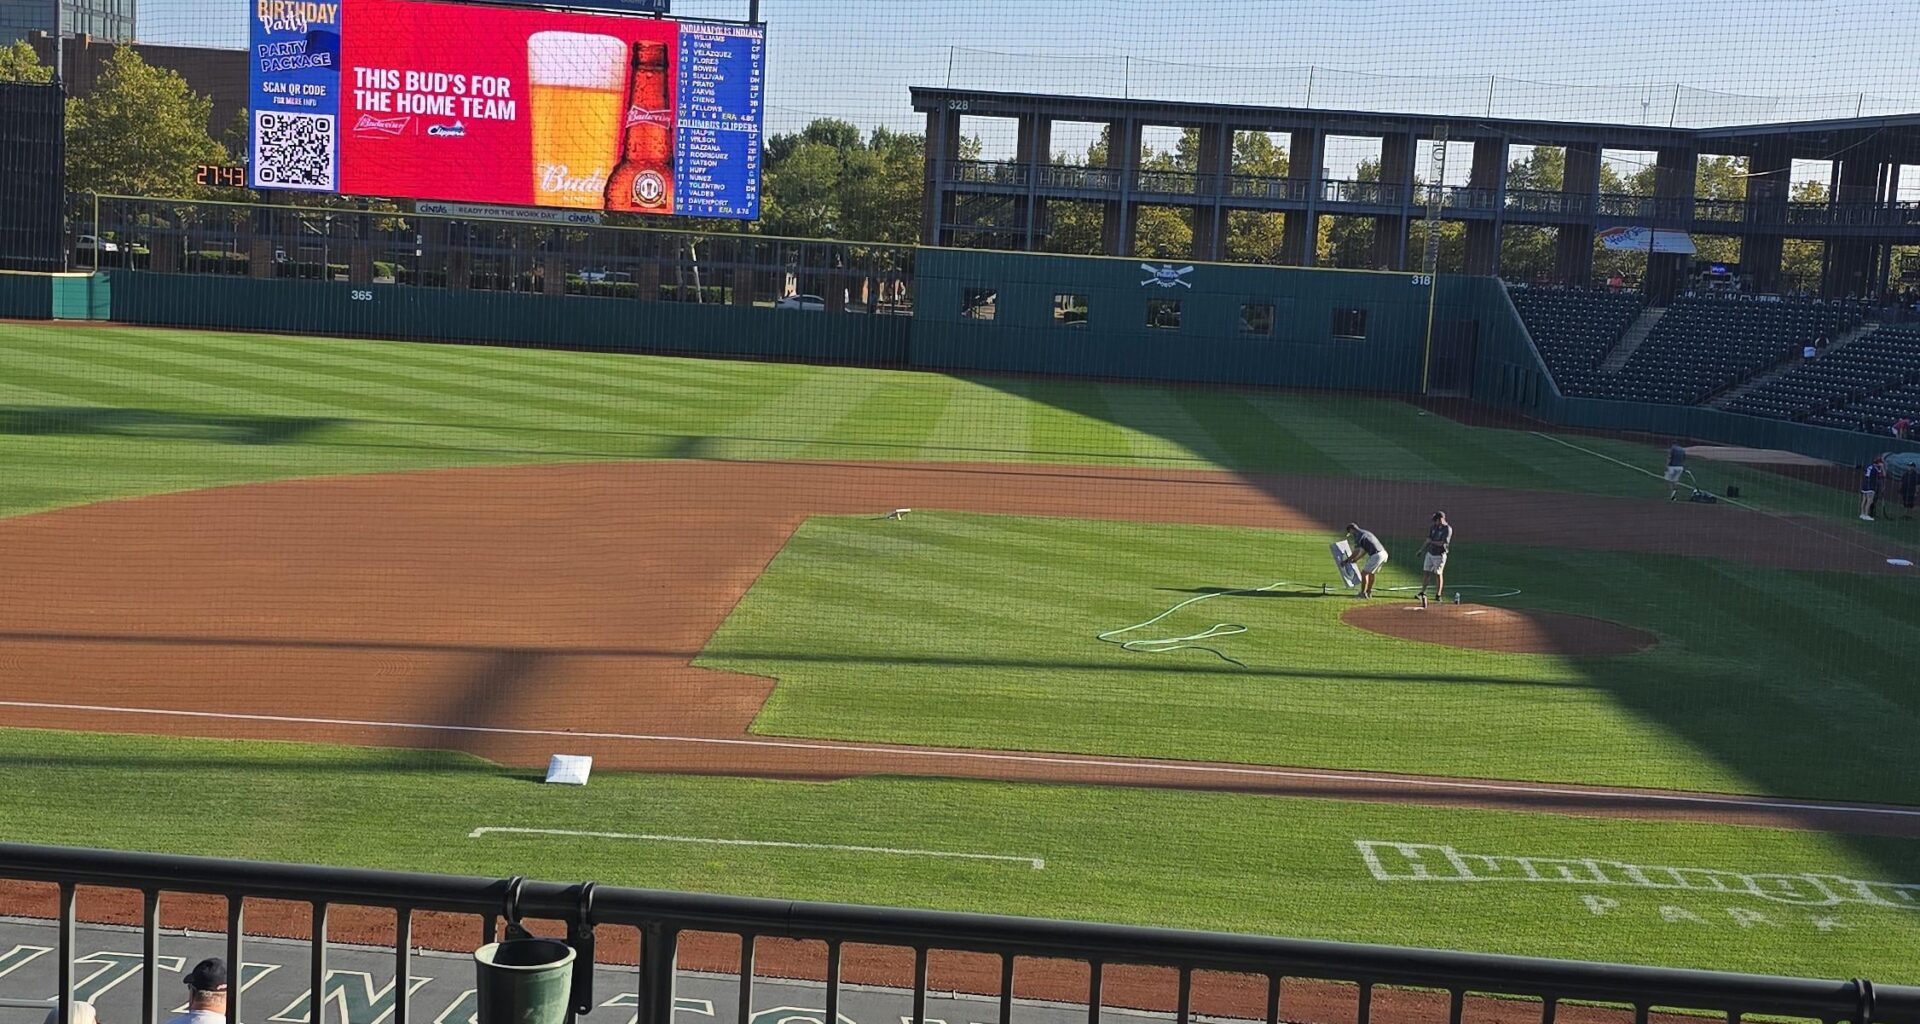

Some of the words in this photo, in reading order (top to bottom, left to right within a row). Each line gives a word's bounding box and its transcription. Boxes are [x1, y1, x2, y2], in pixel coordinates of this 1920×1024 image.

[257, 0, 338, 24] BIRTHDAY
[259, 11, 308, 34] Party
[680, 23, 732, 35] INDIANAPOLIS
[733, 28, 763, 38] INDIANS
[693, 34, 725, 42] WILLIAMS
[258, 40, 308, 57] PARTY
[693, 49, 732, 58] VELAZQUEZ
[260, 52, 332, 73] PACKAGE
[693, 57, 719, 65] FLORES
[692, 65, 718, 73] BOWEN
[692, 72, 724, 81] SULLIVAN
[353, 66, 400, 90] THIS
[405, 70, 466, 95] BUD'S
[471, 75, 511, 98] FOR
[262, 81, 287, 94] SCAN
[288, 83, 301, 95] QR
[303, 84, 327, 96] CODE
[691, 88, 715, 96] JARVIS
[273, 96, 285, 105] FOR
[285, 97, 303, 106] MORE
[303, 98, 317, 107] INFO
[353, 89, 392, 112] THE
[396, 92, 456, 117] HOME
[461, 97, 516, 121] TEAM
[691, 96, 716, 104] CHENG
[949, 100, 969, 110] 328
[678, 119, 720, 129] COLUMBUS
[721, 121, 758, 132] CLIPPERS
[690, 143, 721, 152] BAZZANA
[690, 151, 729, 160] RODRIGUEZ
[689, 159, 718, 167] WATSON
[196, 165, 244, 187] 27:43
[688, 182, 725, 191] TOLENTINO
[688, 189, 715, 197] VALDES
[688, 197, 729, 206] DAVENPORT
[458, 206, 483, 215] READY
[484, 208, 499, 216] FOR
[500, 209, 515, 217] THE
[516, 210, 540, 218] WORK
[541, 211, 557, 219] DAY
[1411, 275, 1431, 285] 318
[351, 290, 373, 301] 365
[1582, 893, 1863, 932] PARK
